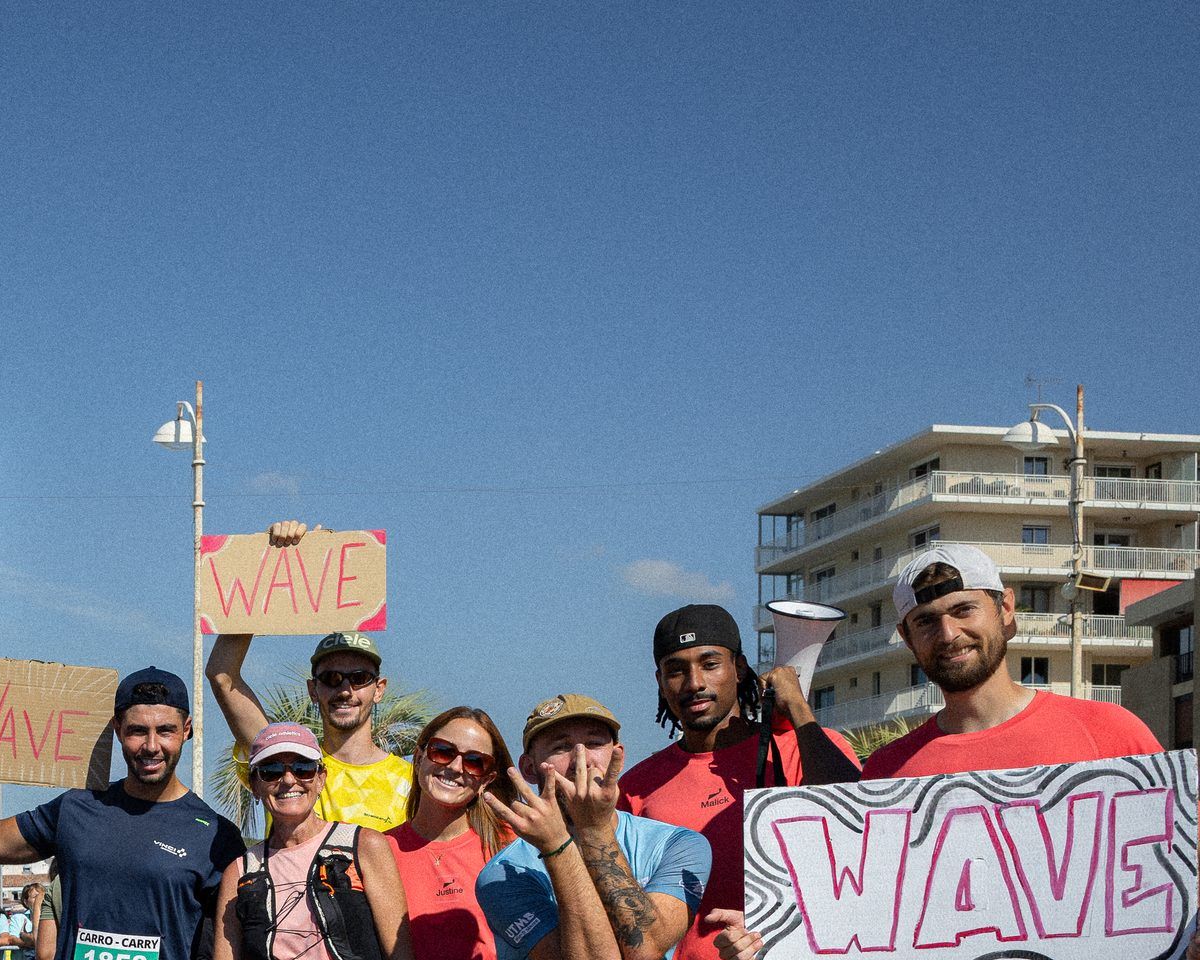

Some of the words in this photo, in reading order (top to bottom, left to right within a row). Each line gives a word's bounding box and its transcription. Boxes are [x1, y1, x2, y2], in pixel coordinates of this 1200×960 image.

[209, 542, 367, 618] WAVE
[323, 633, 371, 649] ciele
[701, 797, 730, 808] Malick
[771, 787, 1176, 955] WAVE
[436, 885, 464, 897] Justine
[79, 931, 114, 946] CARRO
[121, 937, 159, 950] CARRY
